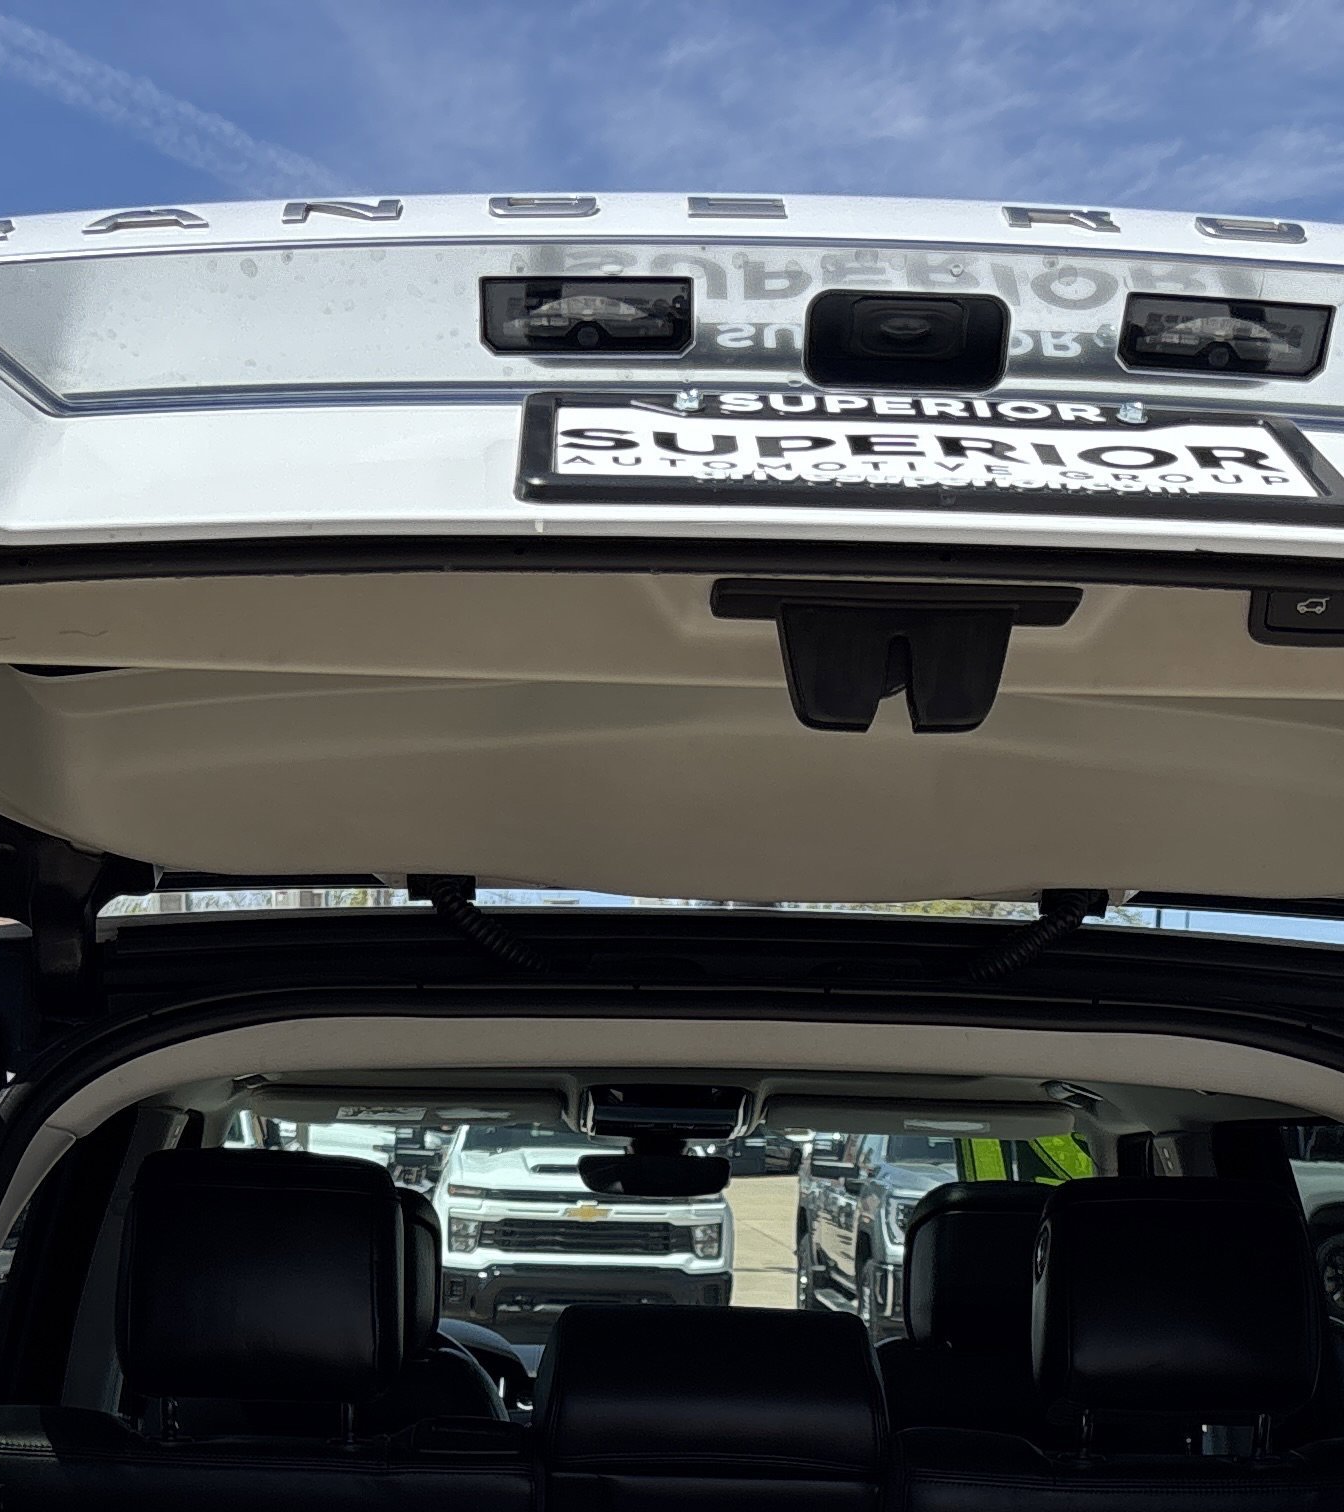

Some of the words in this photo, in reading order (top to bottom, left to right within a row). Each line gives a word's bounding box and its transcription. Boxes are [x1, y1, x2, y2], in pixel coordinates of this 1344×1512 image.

[719, 391, 1107, 423] SUPERIOR
[559, 427, 1288, 473] SUPERIOR
[561, 454, 1012, 478] AUTOMOTIVE
[1059, 469, 1292, 487] GROUP
